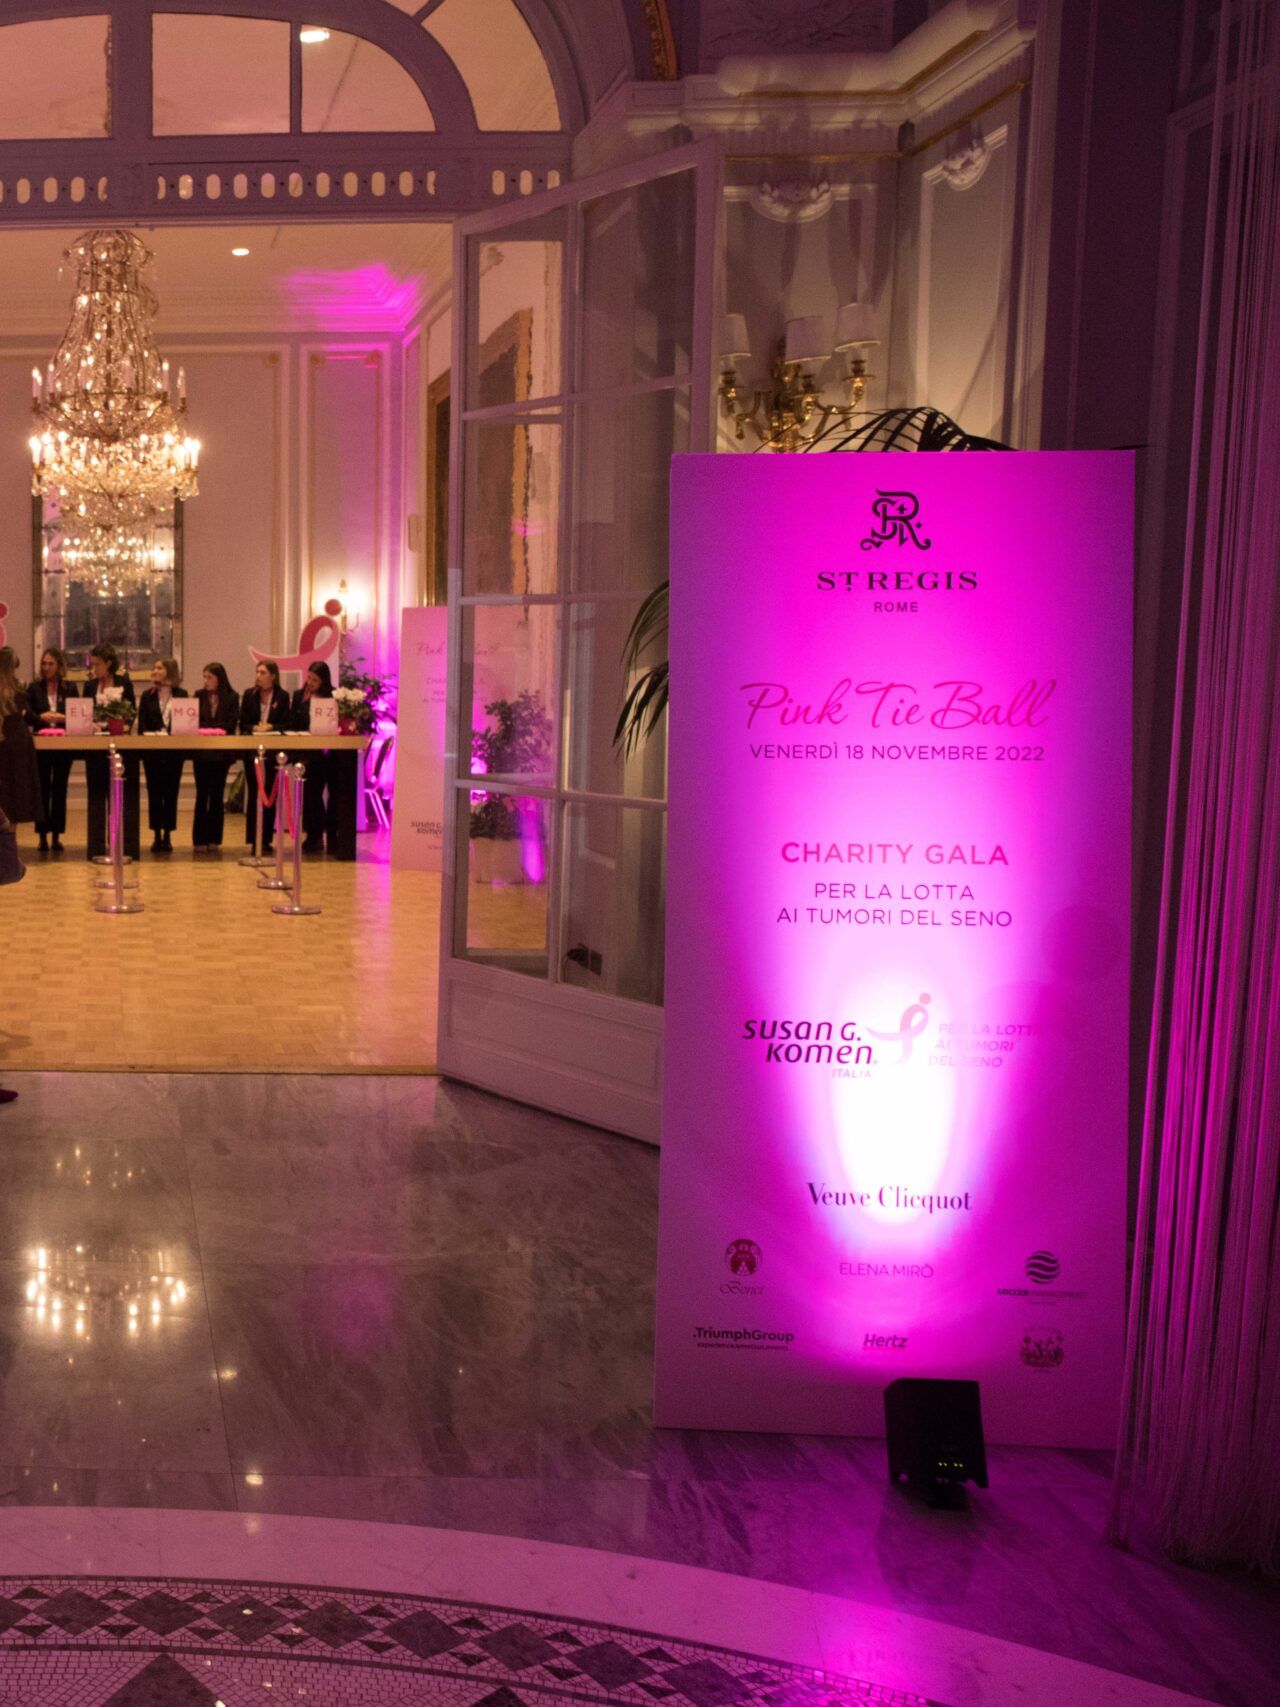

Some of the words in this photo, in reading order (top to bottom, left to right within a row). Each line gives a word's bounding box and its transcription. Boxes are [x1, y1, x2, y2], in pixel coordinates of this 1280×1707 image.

[867, 571, 979, 591] REGIS
[873, 601, 919, 613] ROME
[740, 677, 851, 729] Pink
[854, 681, 924, 729] Tie
[932, 678, 1058, 730] Ball
[750, 742, 838, 760] VENERDÌ
[845, 745, 864, 760] 18
[871, 745, 988, 761] NOVEMBRE
[995, 746, 1046, 762] 2022
[780, 842, 914, 865] CHARITY
[924, 844, 1010, 865] GALA
[814, 883, 857, 900] PER
[864, 883, 892, 900] LA
[901, 884, 975, 901] LOTTA
[776, 908, 798, 924] AI
[805, 907, 892, 925] TUMORI
[900, 909, 942, 926] DEL
[950, 909, 1013, 927] SENO
[807, 1183, 871, 1207] Veuve
[878, 1185, 973, 1214] Clicquot
[839, 1262, 889, 1277] ELENA
[863, 1333, 908, 1348] Hertz
